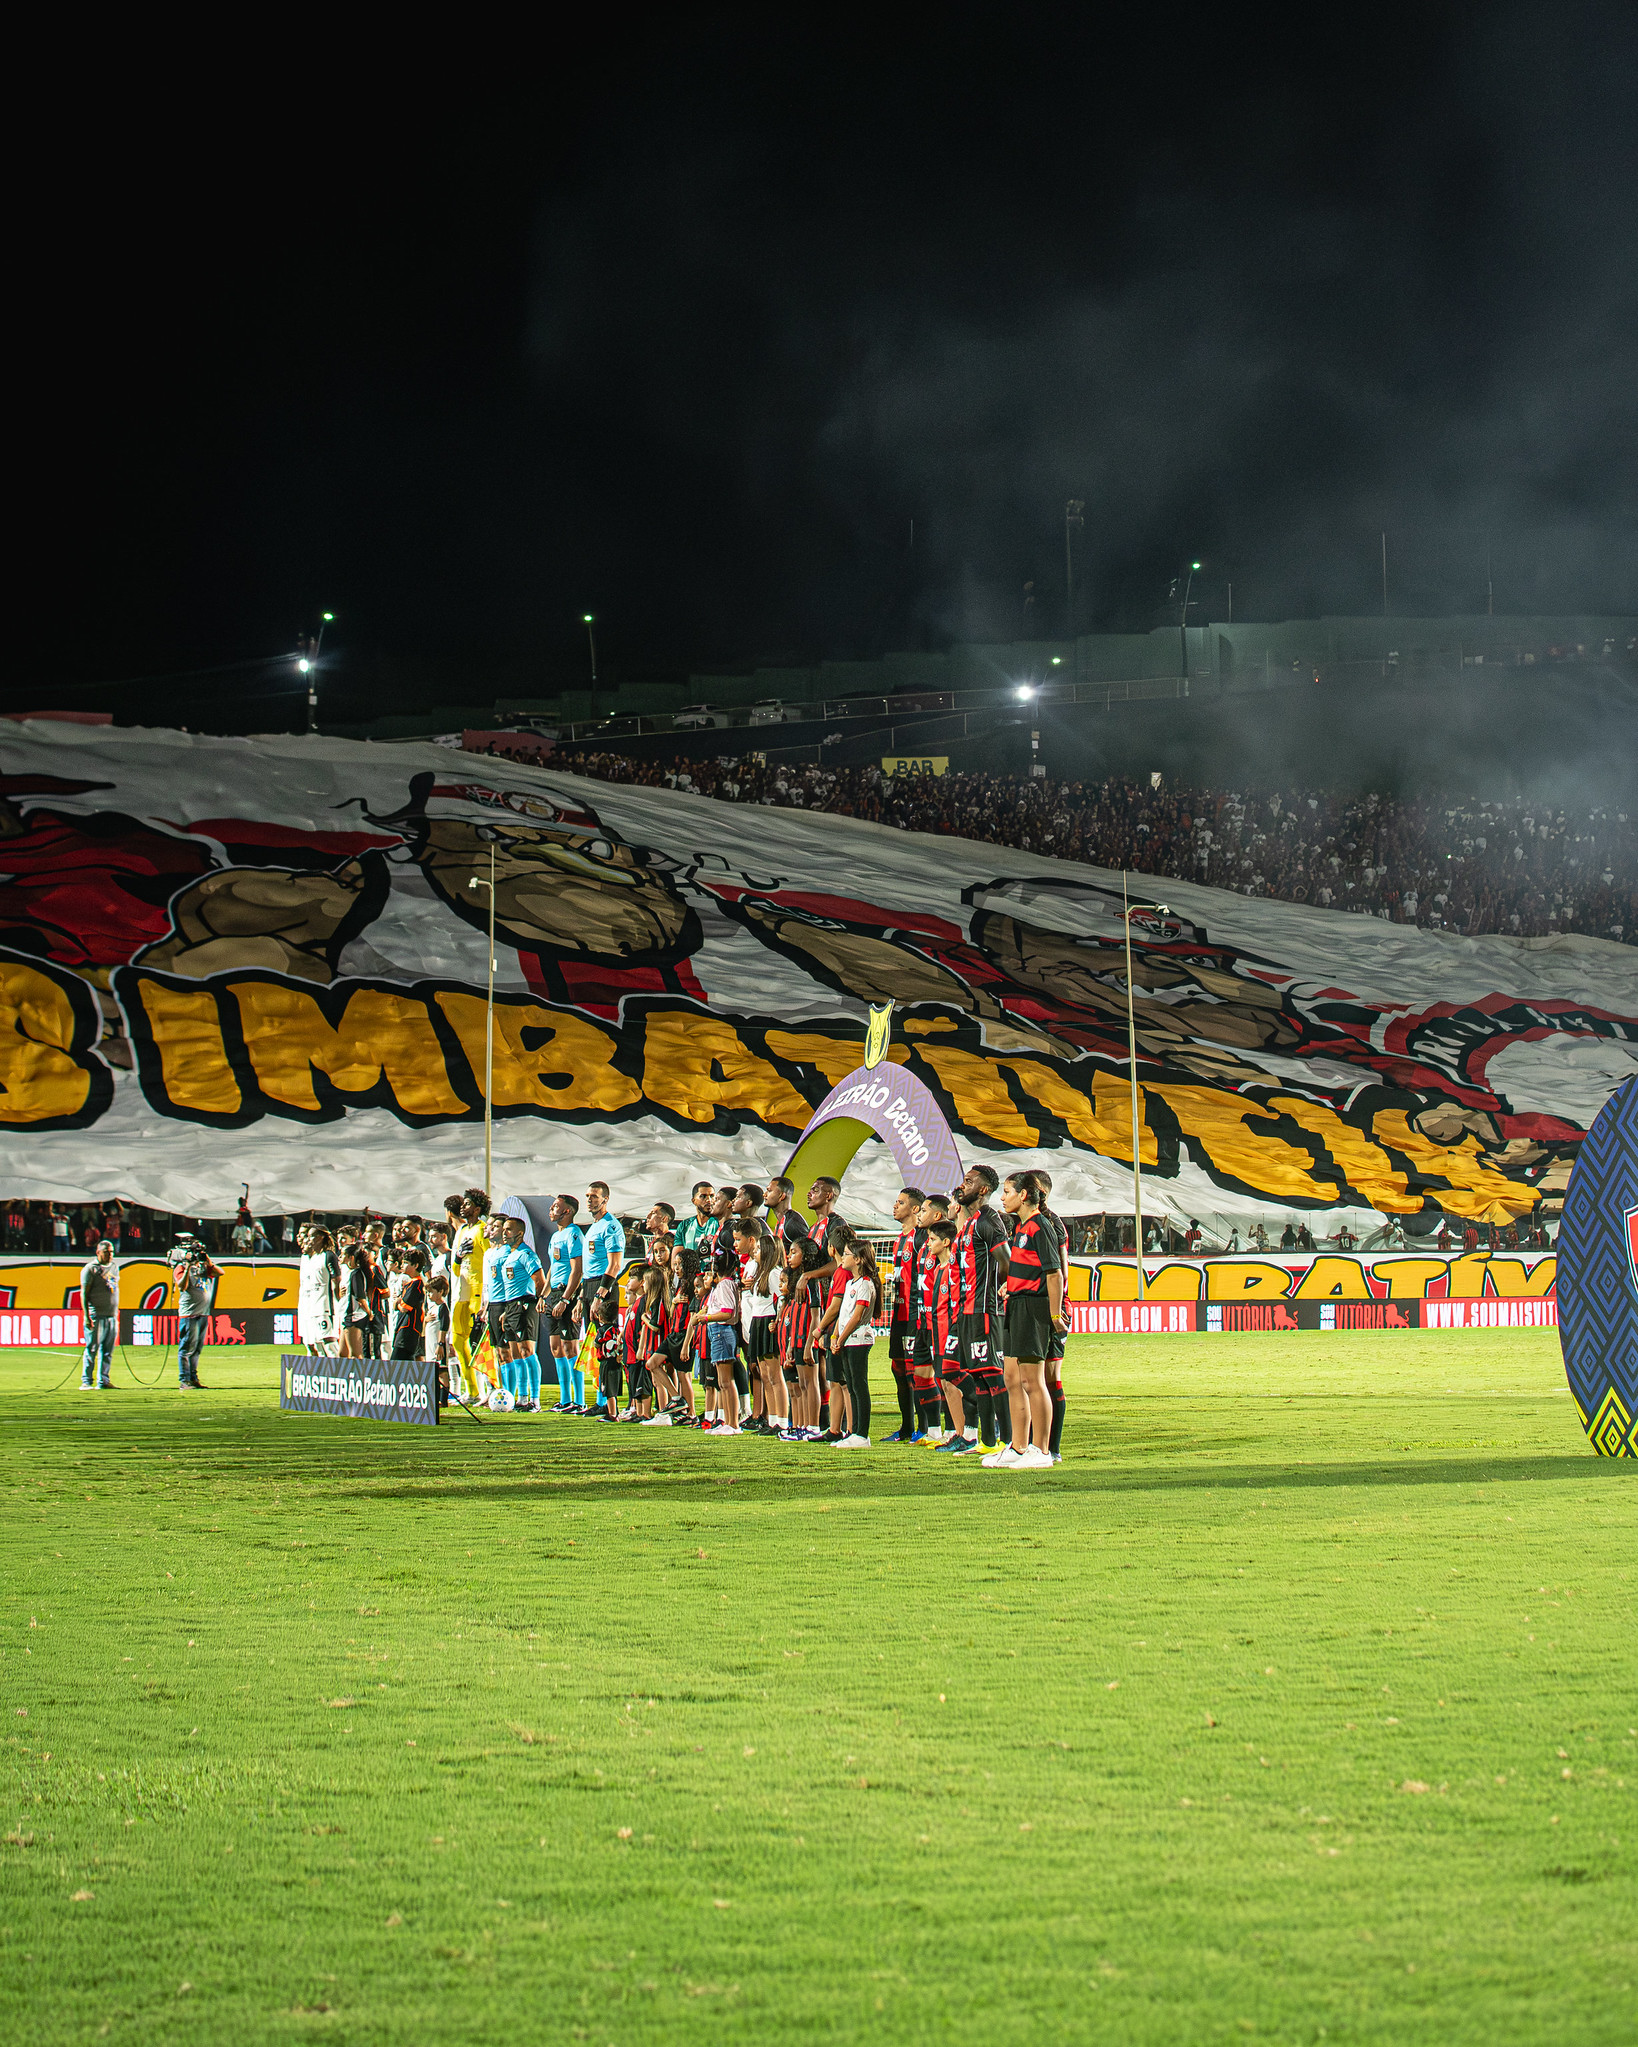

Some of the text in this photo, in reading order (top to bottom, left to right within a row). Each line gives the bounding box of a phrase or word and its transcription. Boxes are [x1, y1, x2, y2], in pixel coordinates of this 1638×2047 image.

[896, 760, 934, 775] BAR
[883, 1096, 929, 1166] Betano
[1206, 1305, 1222, 1320] SOU
[1222, 1303, 1273, 1331] VITÓRIA
[1320, 1304, 1335, 1319] SOU
[1335, 1302, 1384, 1329] VITÓRIA
[292, 1372, 428, 1410] BRASILEIRÃO Betano 2026
